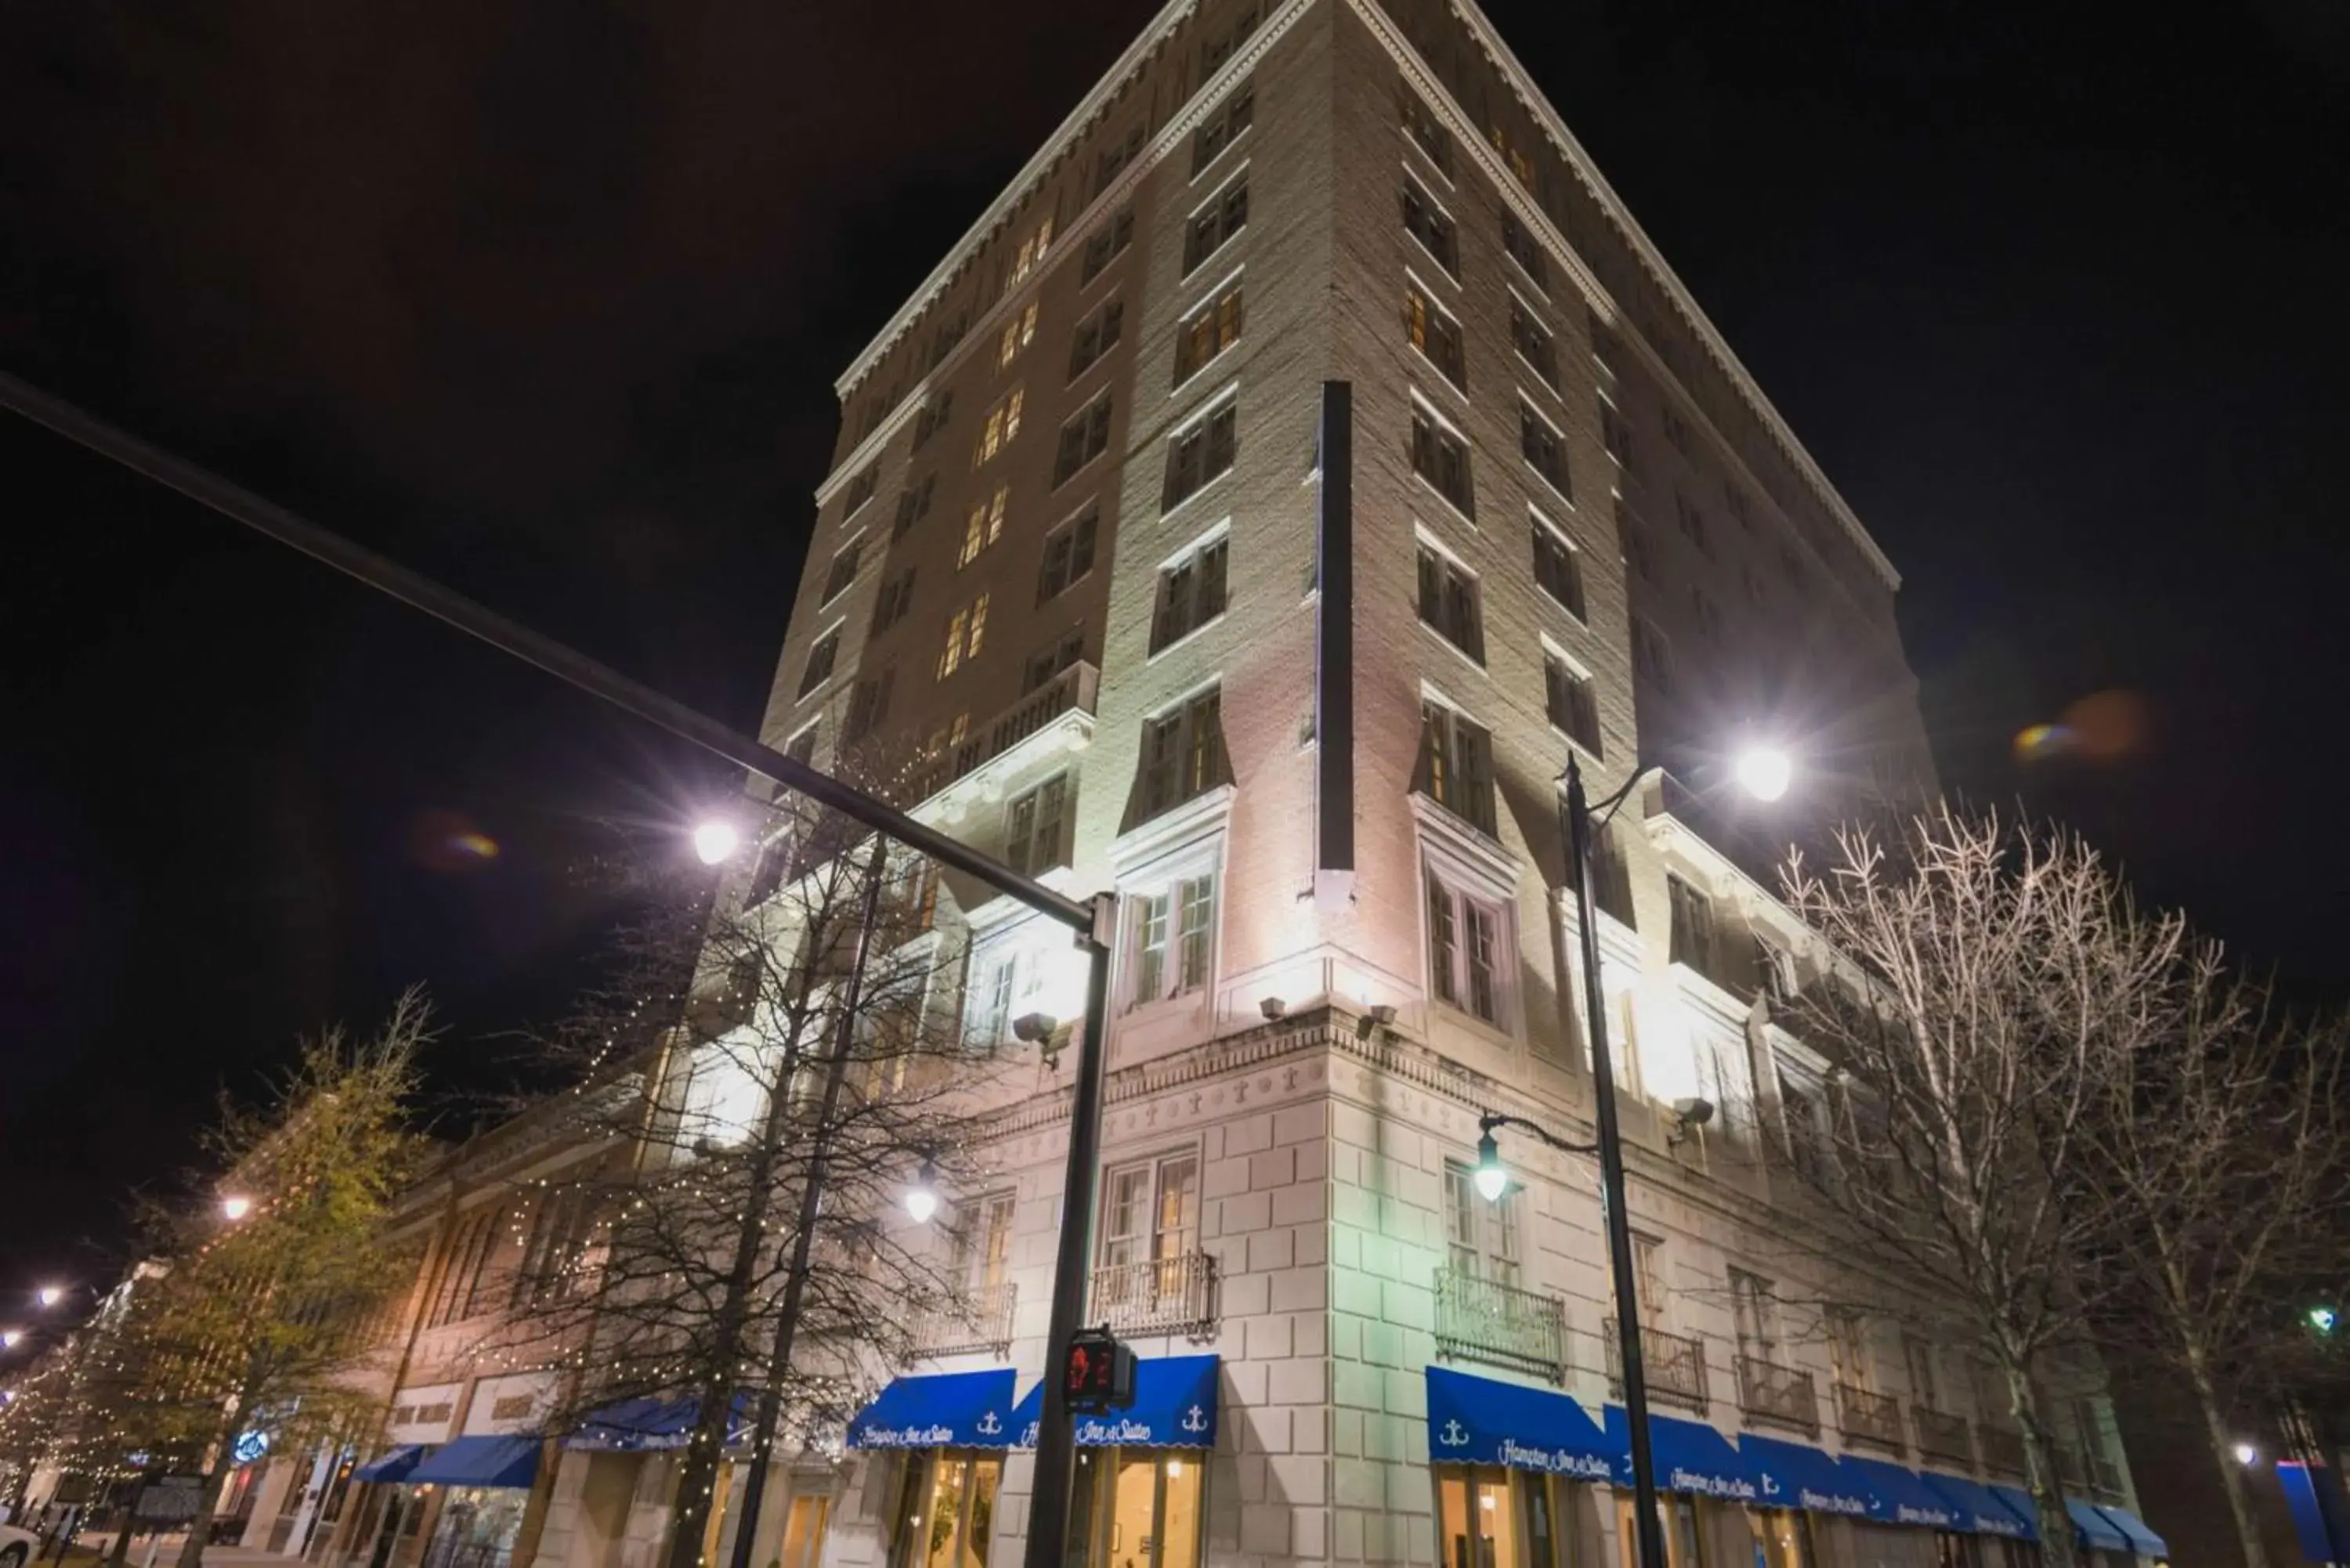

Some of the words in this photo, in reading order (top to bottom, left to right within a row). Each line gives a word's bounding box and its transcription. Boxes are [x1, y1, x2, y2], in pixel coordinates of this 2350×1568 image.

[1078, 1419, 1104, 1443] Inn
[1118, 1418, 1151, 1440] Suites
[1497, 1438, 1551, 1471] Hampton
[1551, 1448, 1576, 1471] Inn
[1585, 1453, 1611, 1476] Suites
